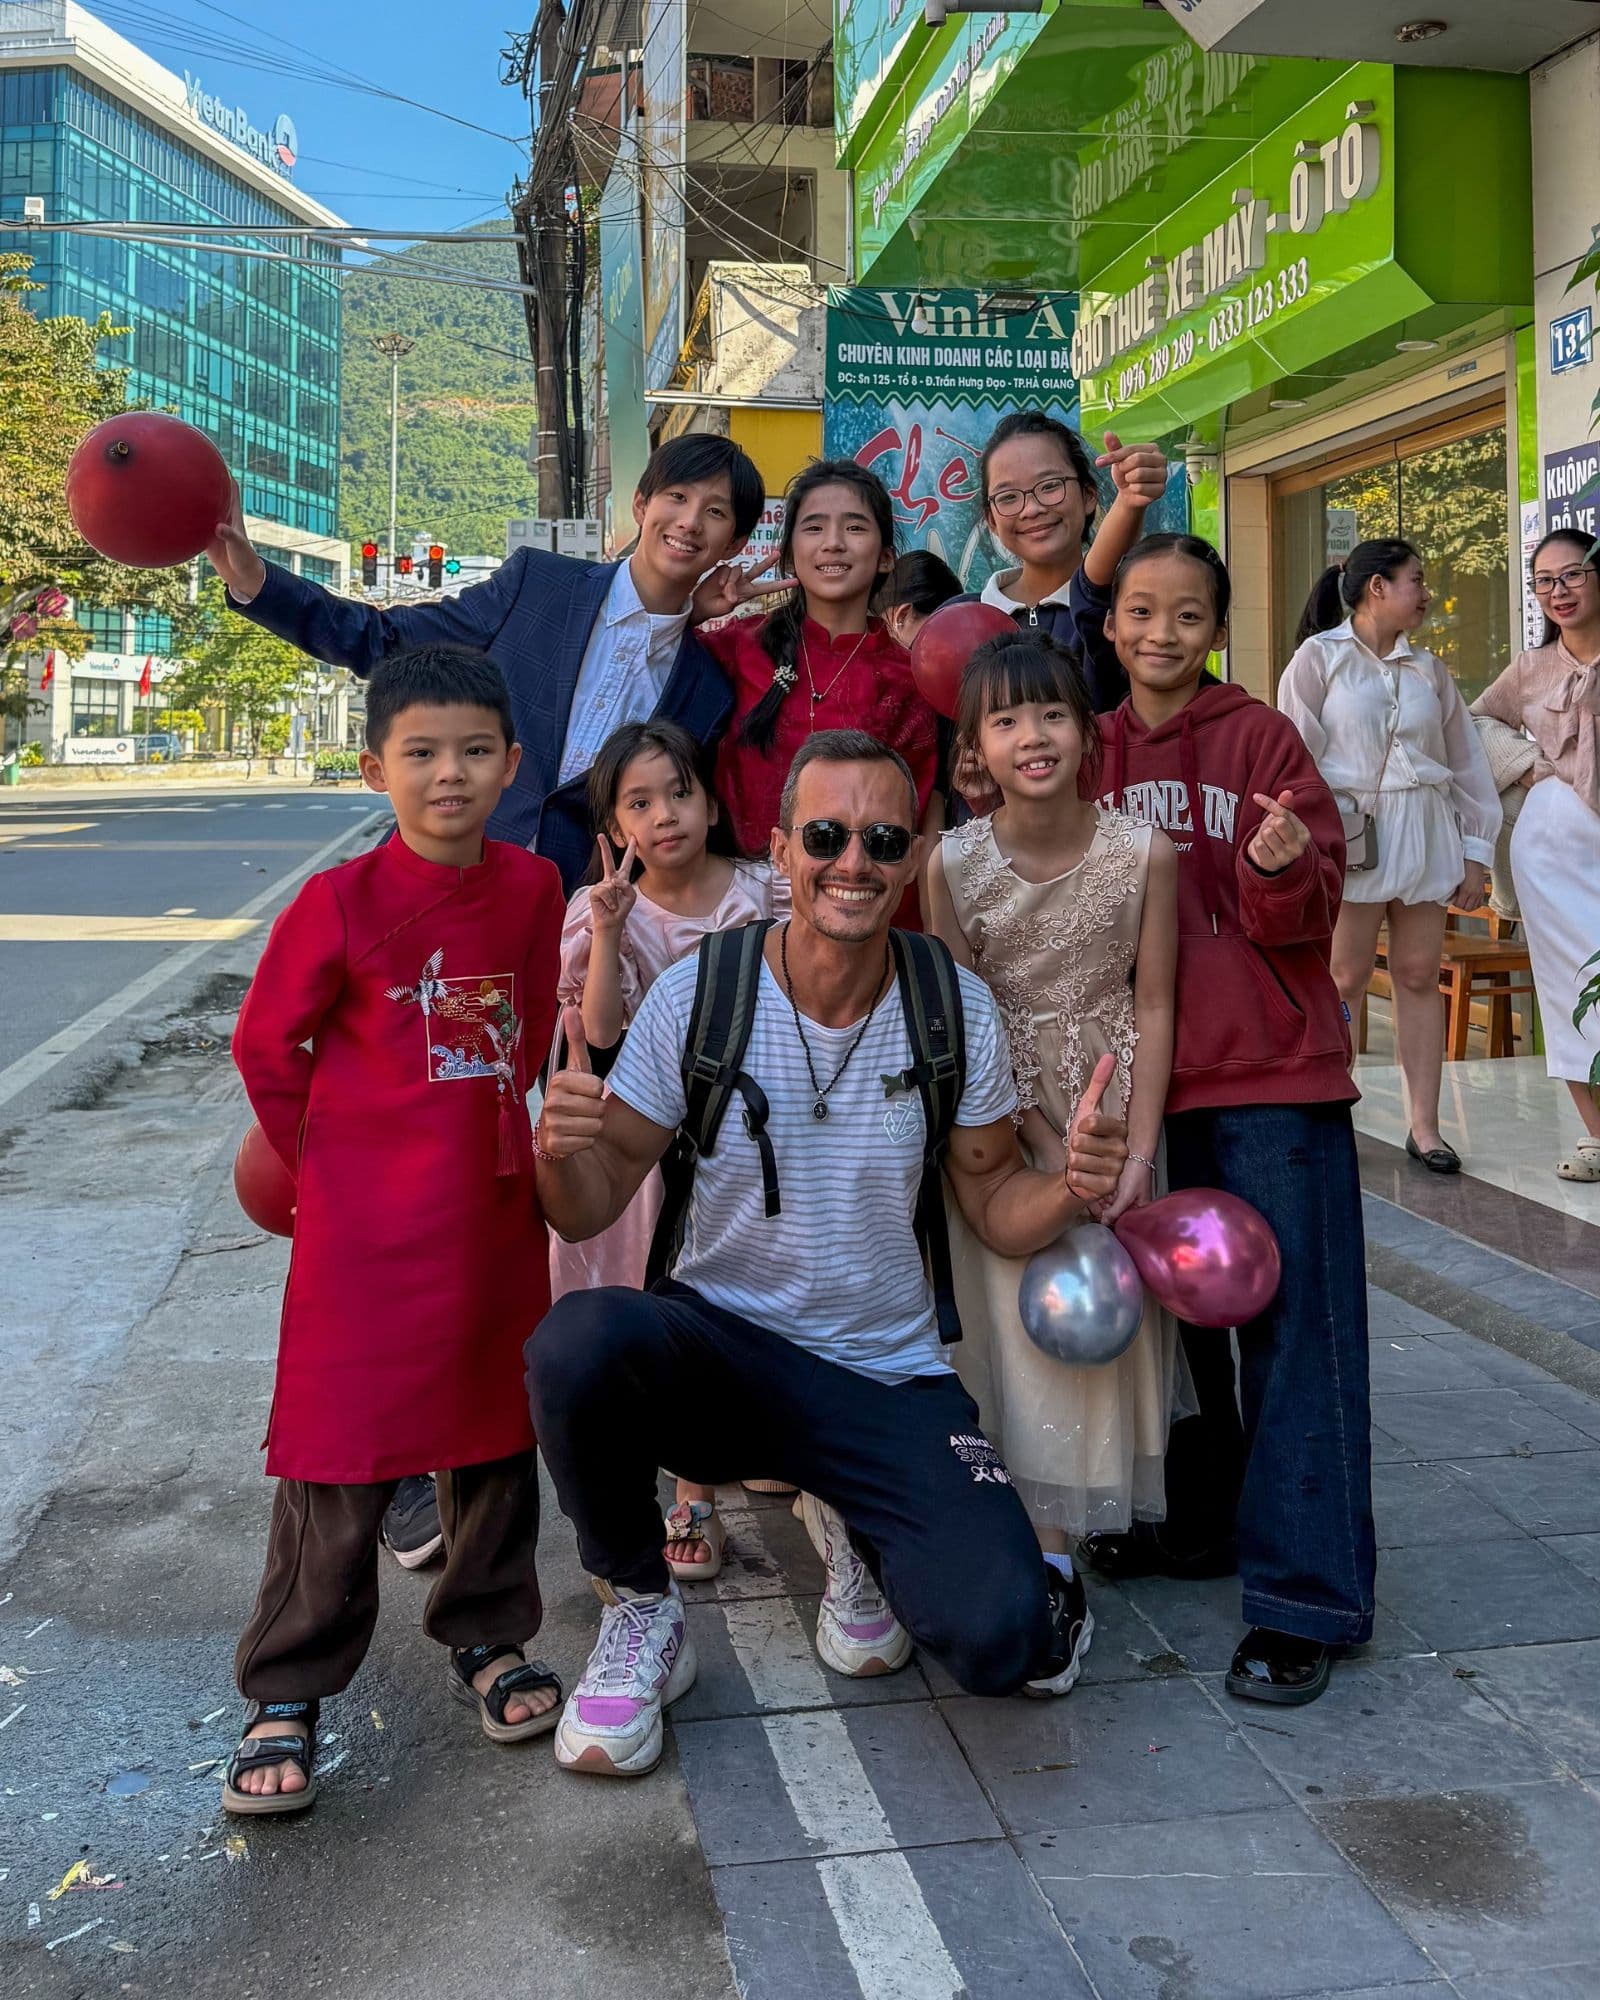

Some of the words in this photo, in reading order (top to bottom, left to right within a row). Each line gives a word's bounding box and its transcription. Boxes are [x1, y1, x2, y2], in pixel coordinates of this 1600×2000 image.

[184, 68, 281, 172] VietinBank
[1071, 316, 1103, 380] CHO
[1107, 256, 1156, 357] THUÊ
[1166, 246, 1194, 321] XE
[1203, 189, 1256, 296] MÁY
[1290, 141, 1309, 233] Ô
[1320, 101, 1363, 214] TÔ
[838, 342, 893, 366] CHUYÊN
[897, 346, 930, 367] KINH
[934, 347, 981, 368] DOANH
[985, 345, 1013, 369] CÁC
[1017, 347, 1047, 373] LOẠI
[1119, 358, 1146, 401] 0976
[1149, 344, 1169, 385] 289
[1172, 329, 1194, 371] 289
[1208, 300, 1243, 352] 0333
[1247, 280, 1273, 328] 123
[1277, 257, 1307, 309] 333
[1555, 314, 1587, 362] 131
[838, 372, 856, 384] ĐC:
[873, 373, 890, 385] 125
[898, 371, 910, 386] Tổ
[911, 375, 917, 386] 8
[958, 376, 984, 390] Hưng
[986, 376, 1006, 391] Đạo
[1014, 375, 1040, 389] TP.HÀ
[1042, 378, 1075, 390] GIANG
